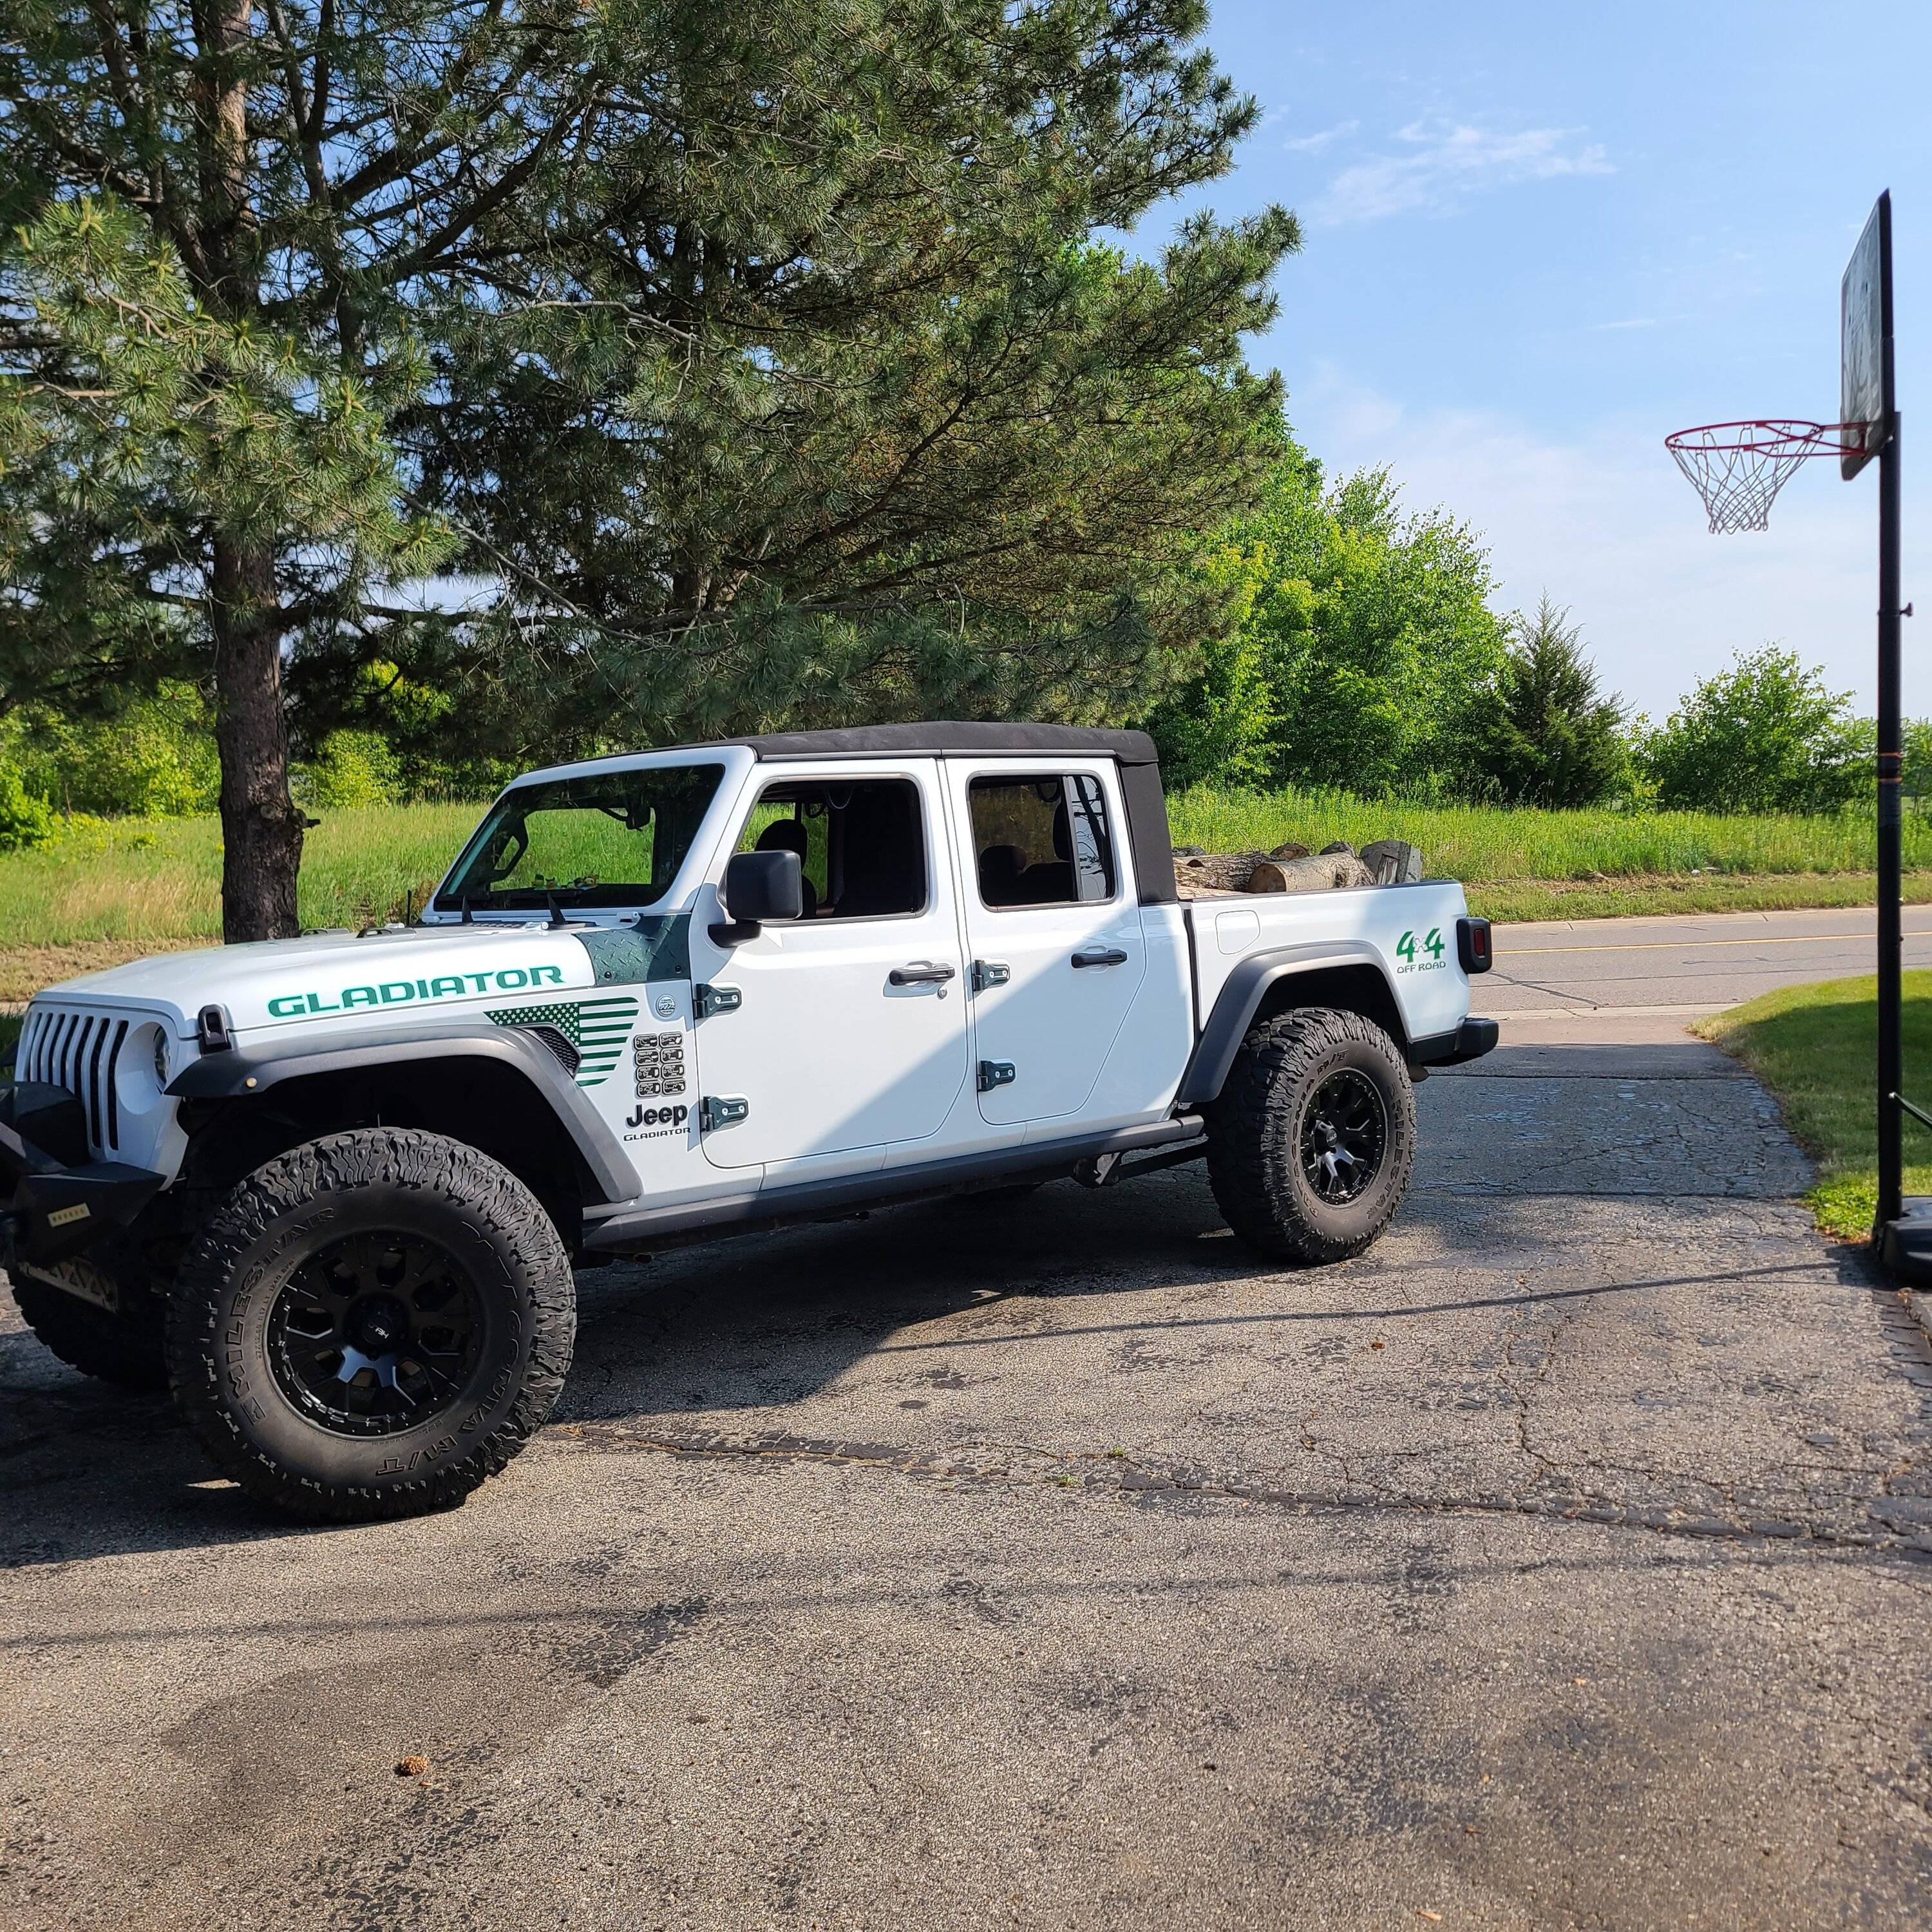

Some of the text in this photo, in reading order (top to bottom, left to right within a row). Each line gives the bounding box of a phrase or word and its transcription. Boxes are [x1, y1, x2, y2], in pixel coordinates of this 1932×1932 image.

[1397, 961, 1446, 974] OFF ROAD
[268, 967, 565, 1018] GLADIATOR
[627, 1104, 688, 1127] Jeep
[623, 1127, 691, 1141] GLADIATOR
[226, 1208, 335, 1398] MILESTAR
[375, 1434, 458, 1475] M/T
